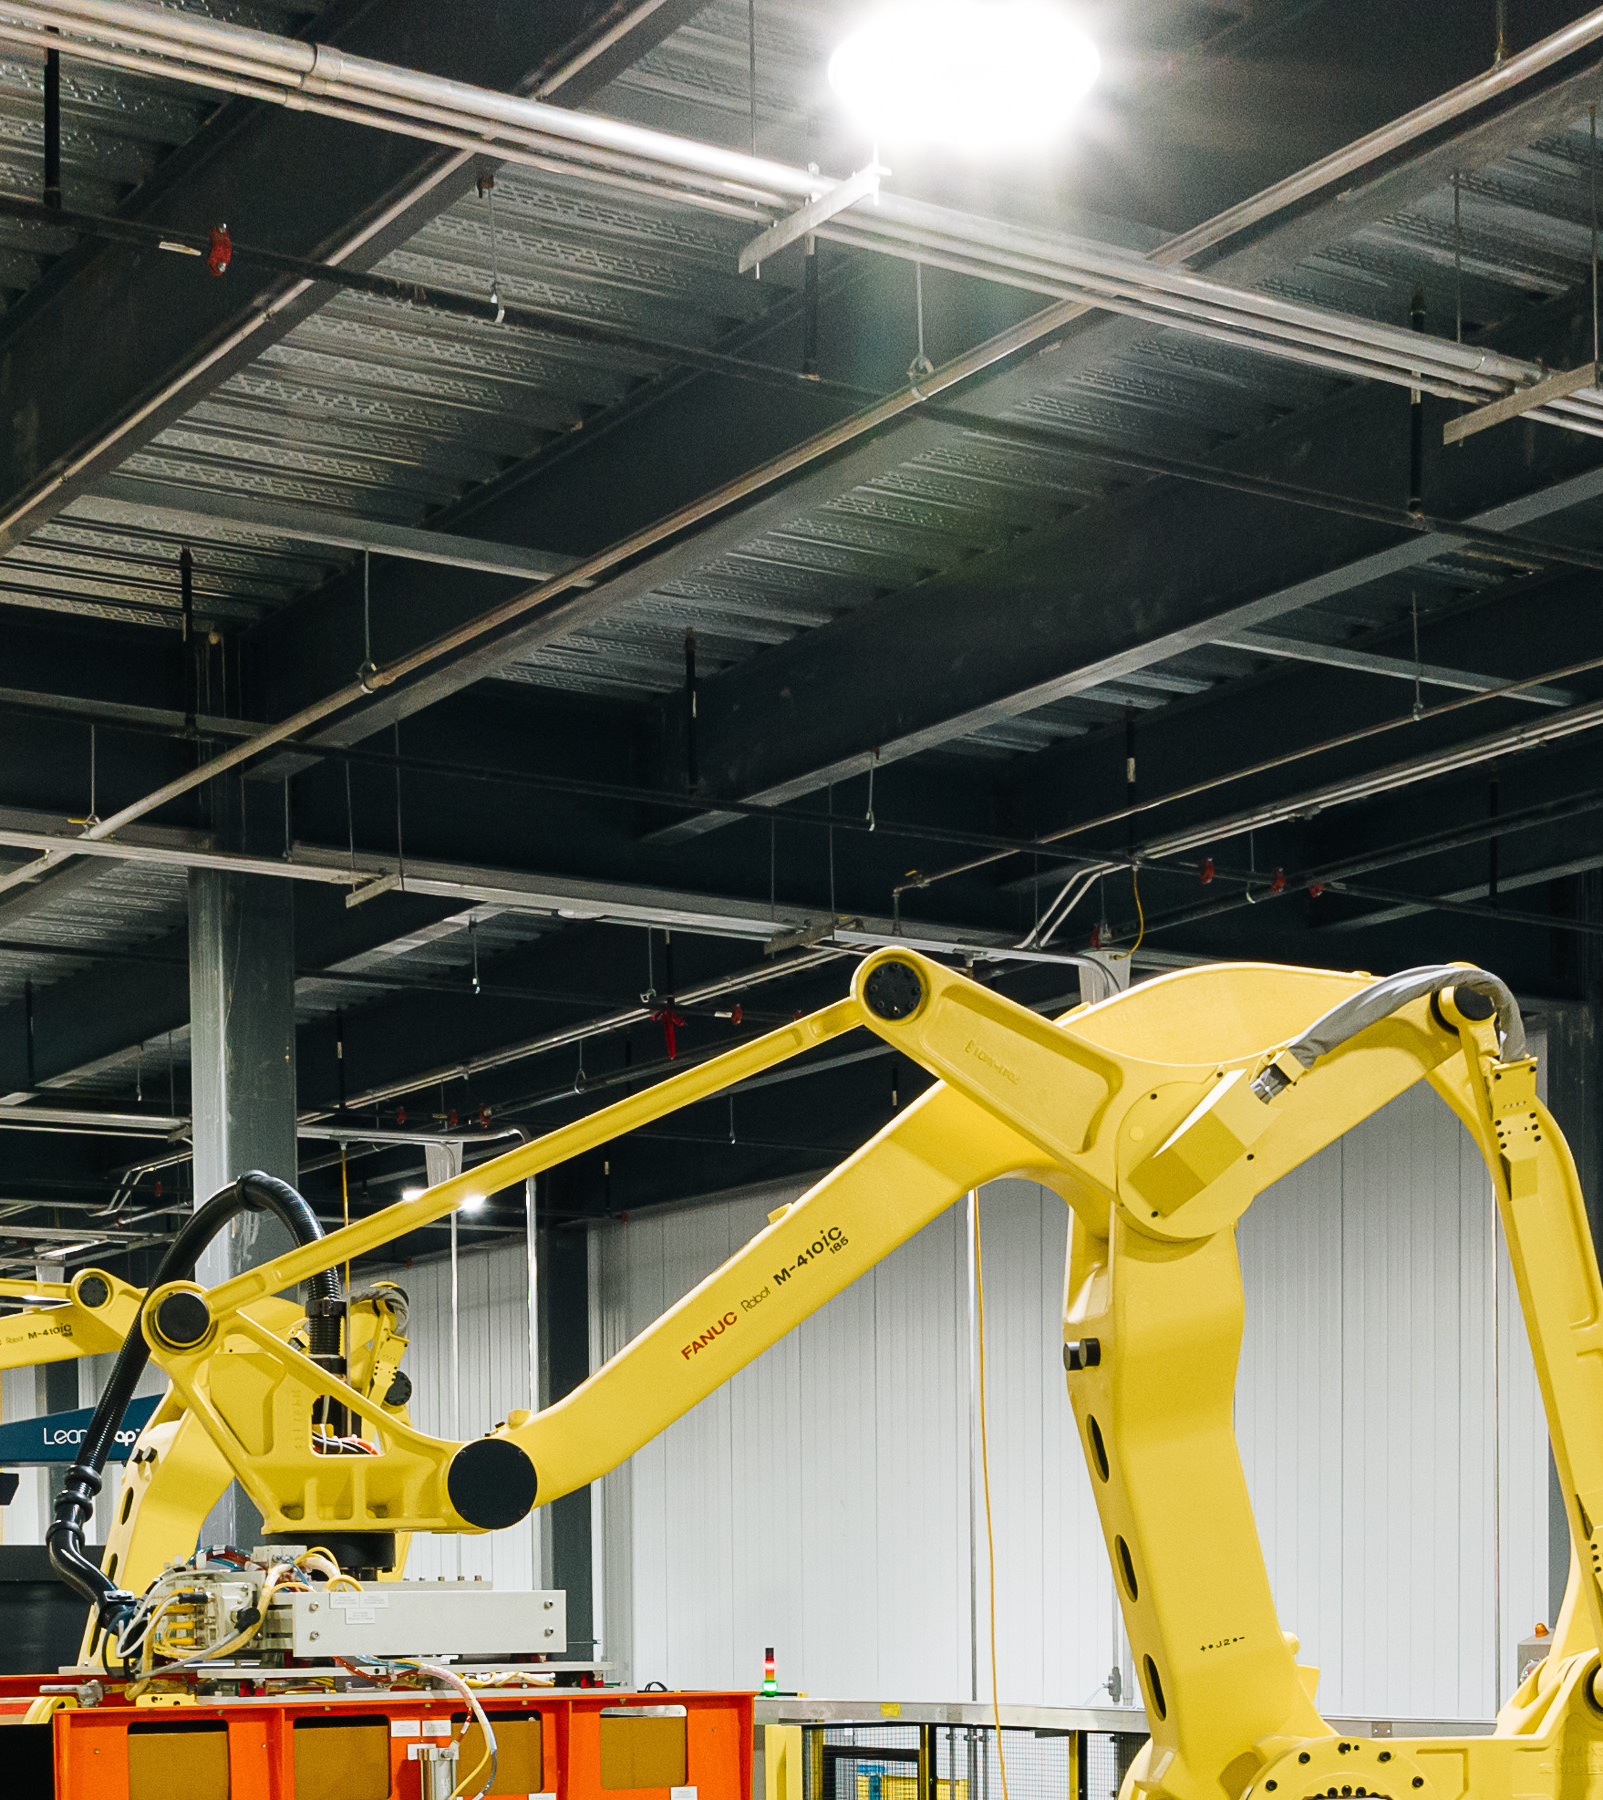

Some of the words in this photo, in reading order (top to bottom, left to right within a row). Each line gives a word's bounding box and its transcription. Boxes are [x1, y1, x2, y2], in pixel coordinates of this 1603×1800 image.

[829, 1236, 849, 1254] 185
[681, 1312, 737, 1360] FANUC
[741, 1286, 771, 1312] Robot
[773, 1227, 842, 1286] M-410iC
